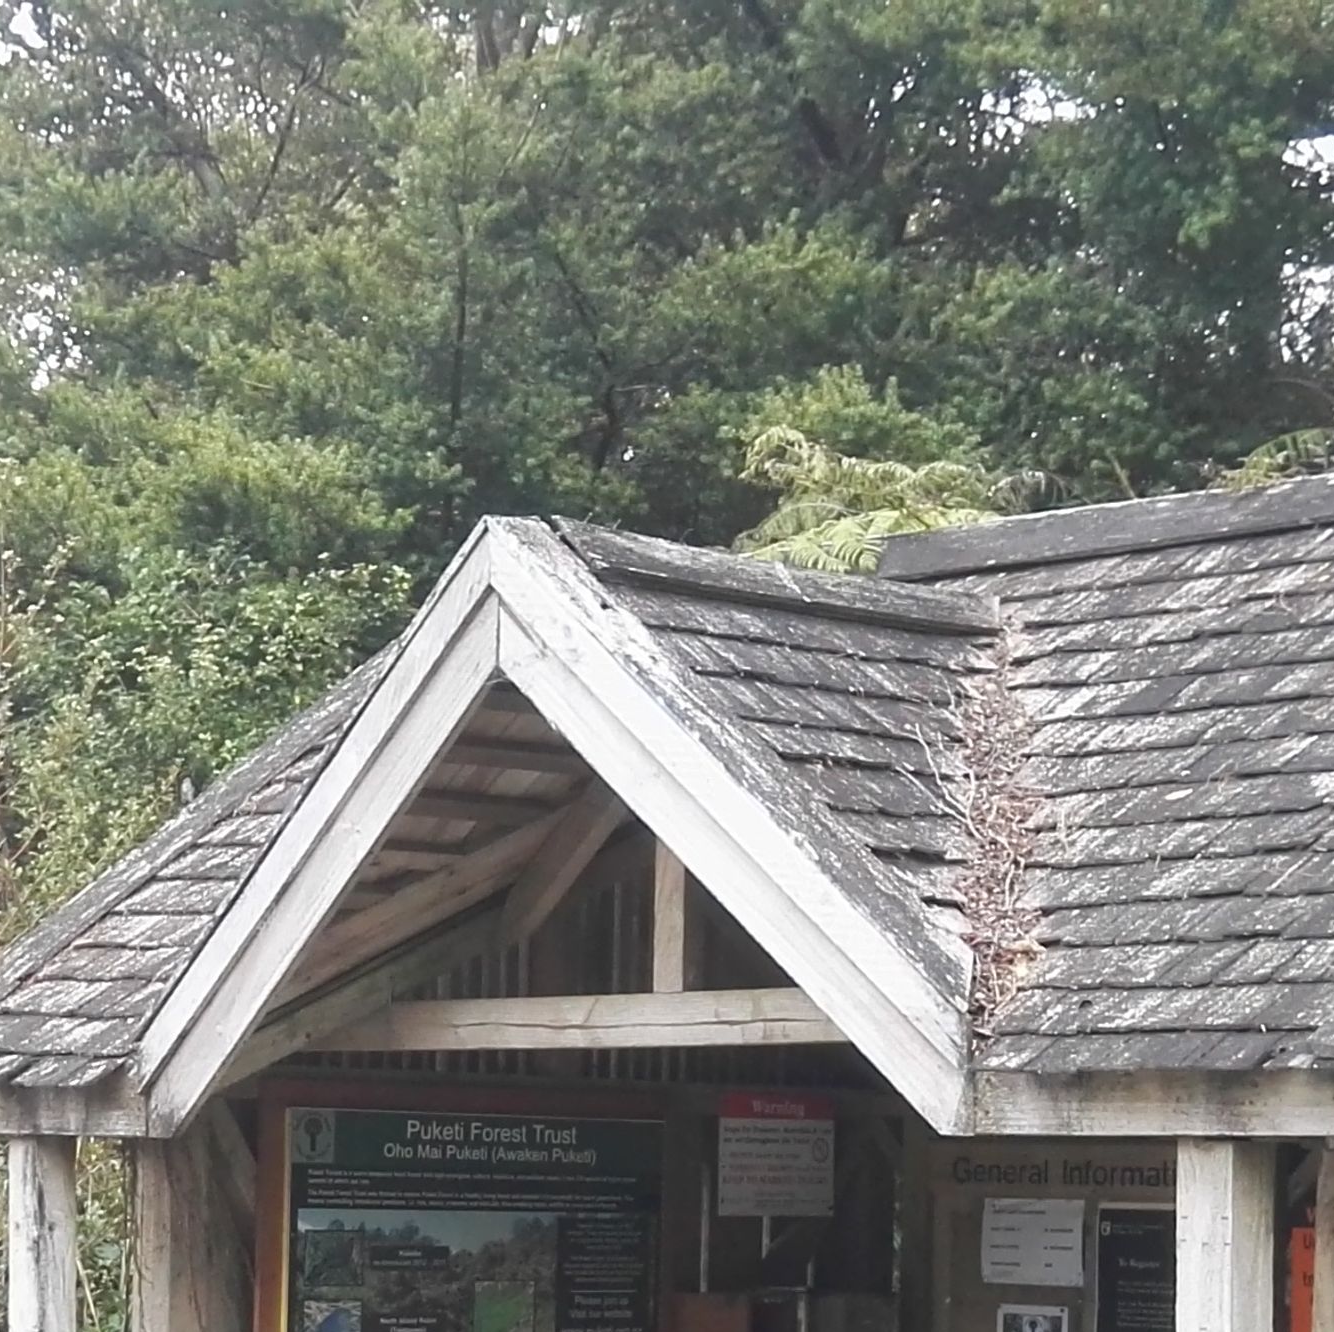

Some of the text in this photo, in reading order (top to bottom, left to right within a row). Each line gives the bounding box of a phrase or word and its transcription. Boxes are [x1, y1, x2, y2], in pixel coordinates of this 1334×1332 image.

[407, 1120, 576, 1144] Puketi Forest Trust
[383, 1143, 413, 1158] Oho
[418, 1144, 442, 1159] Mai
[446, 1145, 487, 1161] Puketi
[492, 1146, 547, 1164] (Awaken
[952, 1156, 1048, 1185] General
